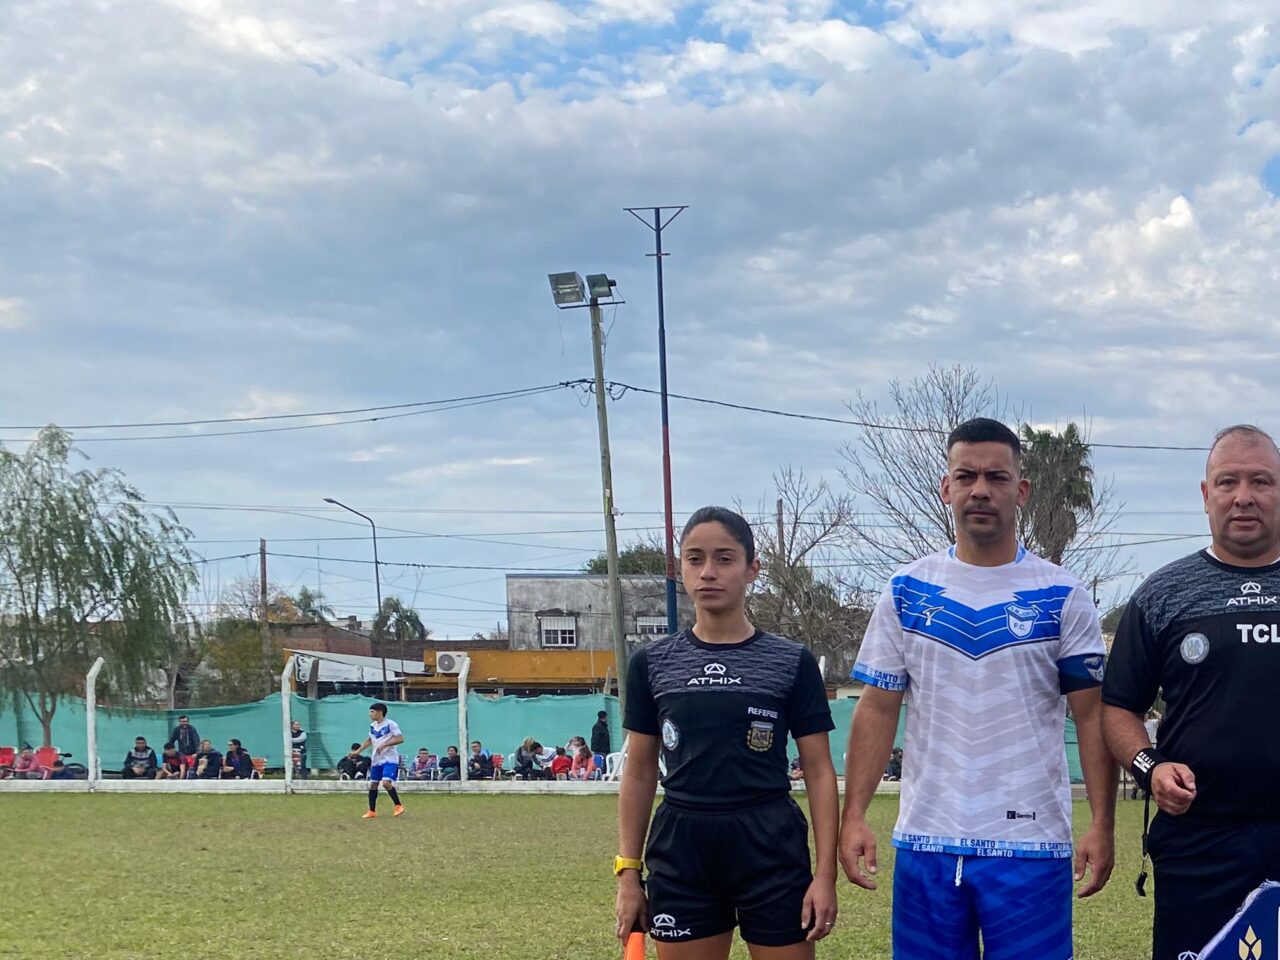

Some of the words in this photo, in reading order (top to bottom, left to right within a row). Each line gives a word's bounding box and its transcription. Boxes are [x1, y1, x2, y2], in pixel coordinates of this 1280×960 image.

[1226, 596, 1278, 606] ATHIX
[873, 669, 899, 683] SANTO
[686, 677, 742, 686] ATHIX
[747, 706, 779, 719] REFEREE
[908, 834, 931, 844] SANTO
[960, 838, 969, 847] EL
[970, 839, 996, 848] SANTO
[921, 845, 944, 853] SANTO
[977, 848, 986, 857] EL
[986, 849, 1013, 857] SANTO
